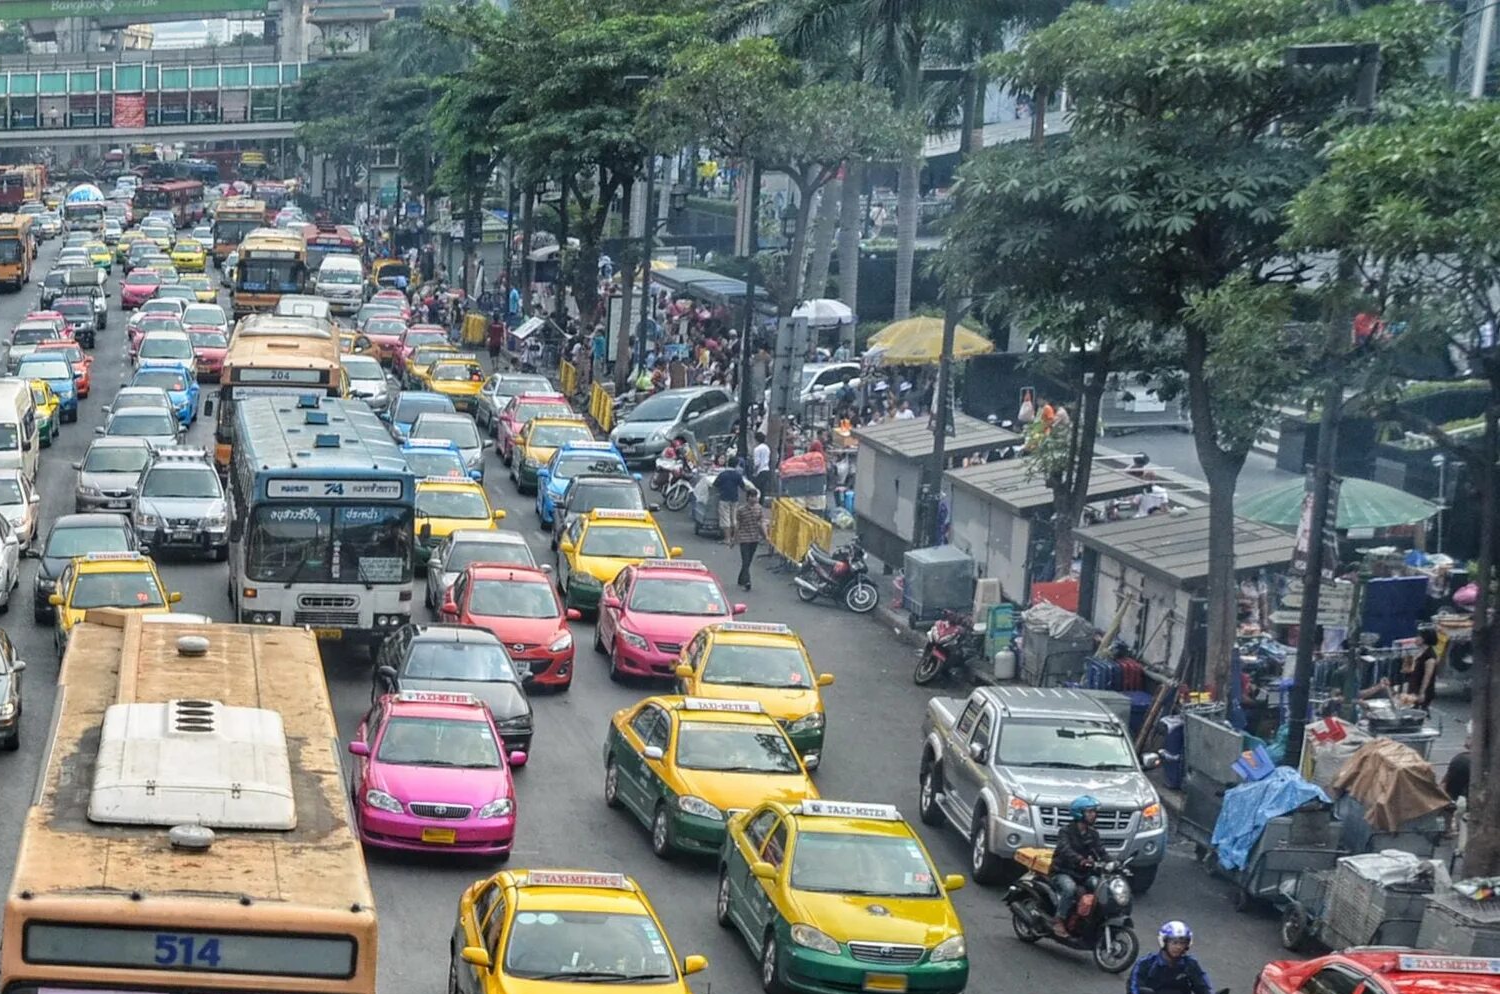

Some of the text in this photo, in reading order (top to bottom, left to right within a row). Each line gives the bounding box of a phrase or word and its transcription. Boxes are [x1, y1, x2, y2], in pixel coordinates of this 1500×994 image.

[324, 483, 344, 495] 74
[546, 874, 609, 886] TAXI-METER
[154, 934, 221, 966] 514
[1415, 959, 1489, 970] TAXI-METER
